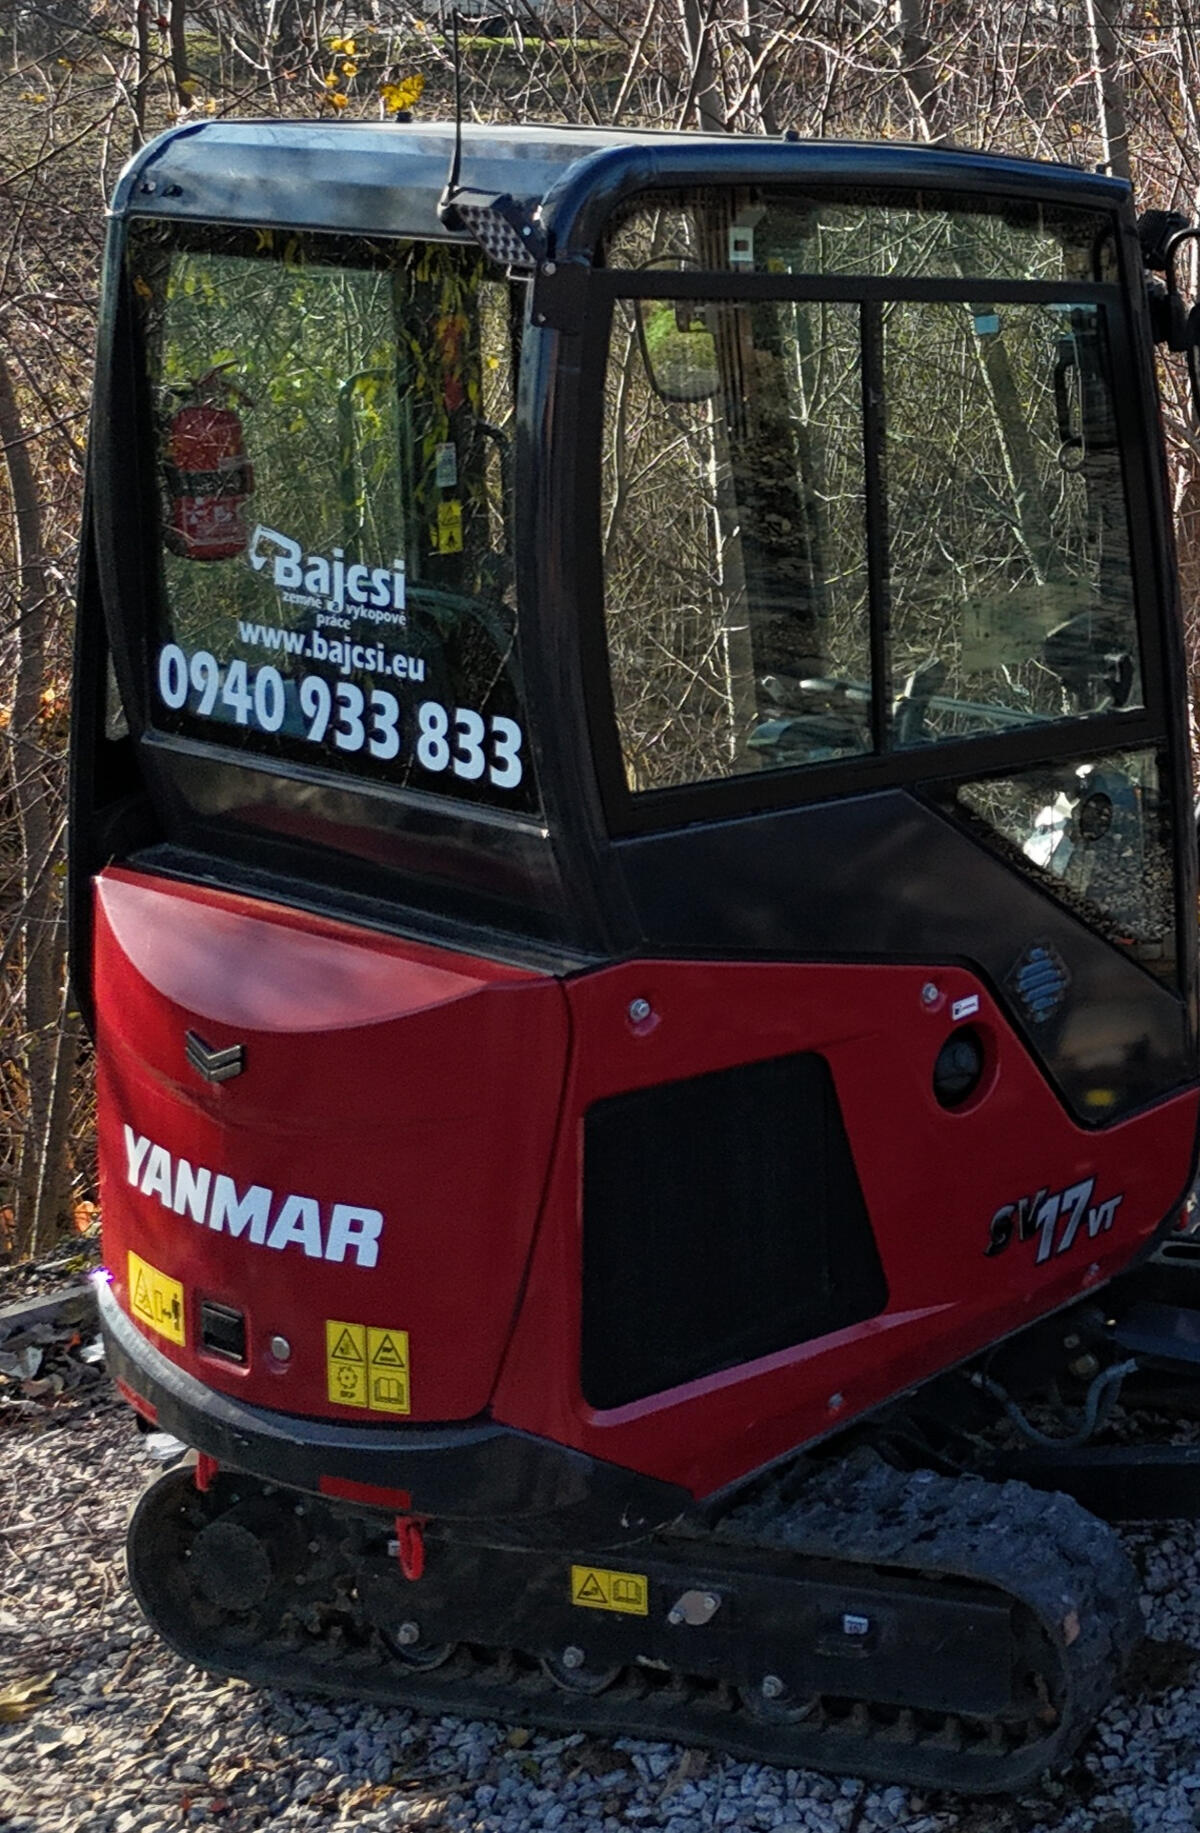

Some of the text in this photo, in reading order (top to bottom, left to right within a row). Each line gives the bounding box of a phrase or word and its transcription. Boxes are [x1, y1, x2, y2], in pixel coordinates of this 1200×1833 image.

[250, 524, 406, 612] Bajcsi
[239, 621, 425, 682] www.bajcsi.eu
[158, 643, 523, 789] 0940 933 833
[123, 1123, 384, 1268] YANMAR
